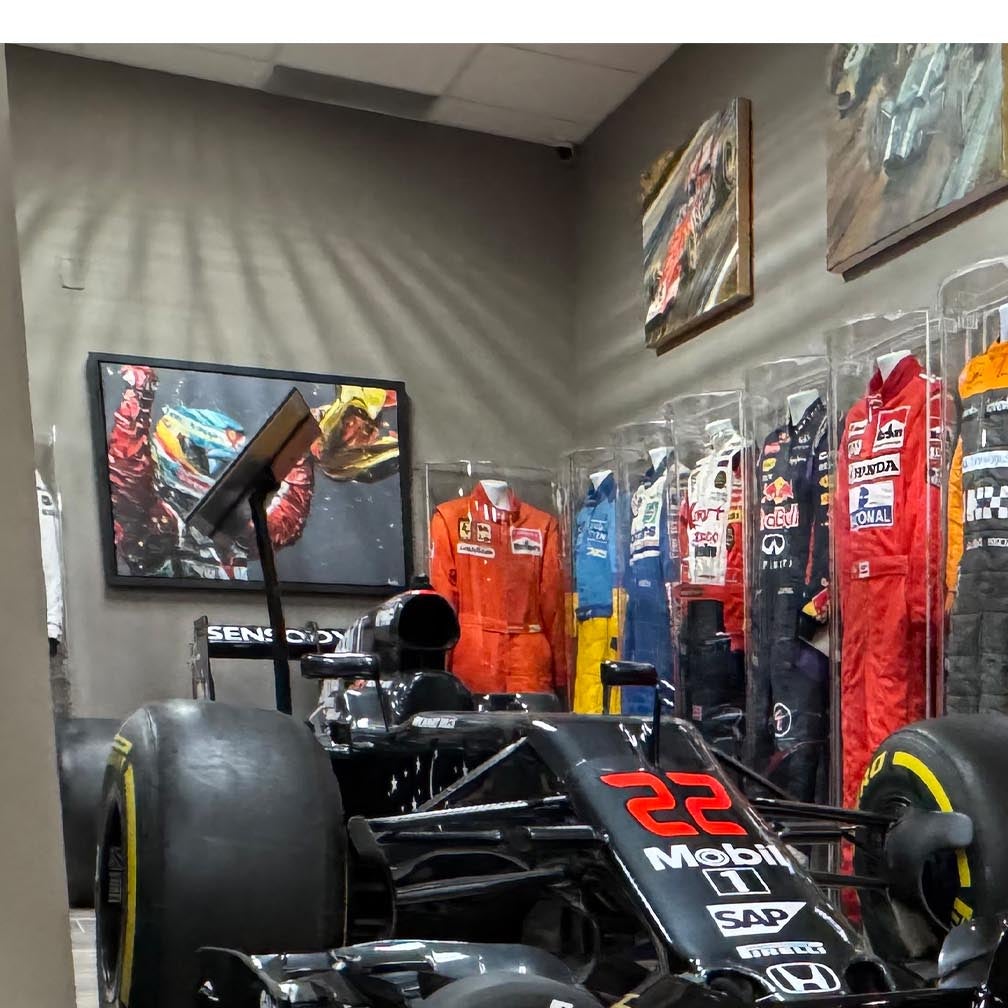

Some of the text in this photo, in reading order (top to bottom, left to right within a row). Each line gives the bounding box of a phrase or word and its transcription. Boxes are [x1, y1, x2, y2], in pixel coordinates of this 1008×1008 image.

[854, 460, 899, 479] HNDA
[600, 772, 748, 836] 22
[643, 843, 789, 871] Mobil
[714, 907, 790, 930] SAP
